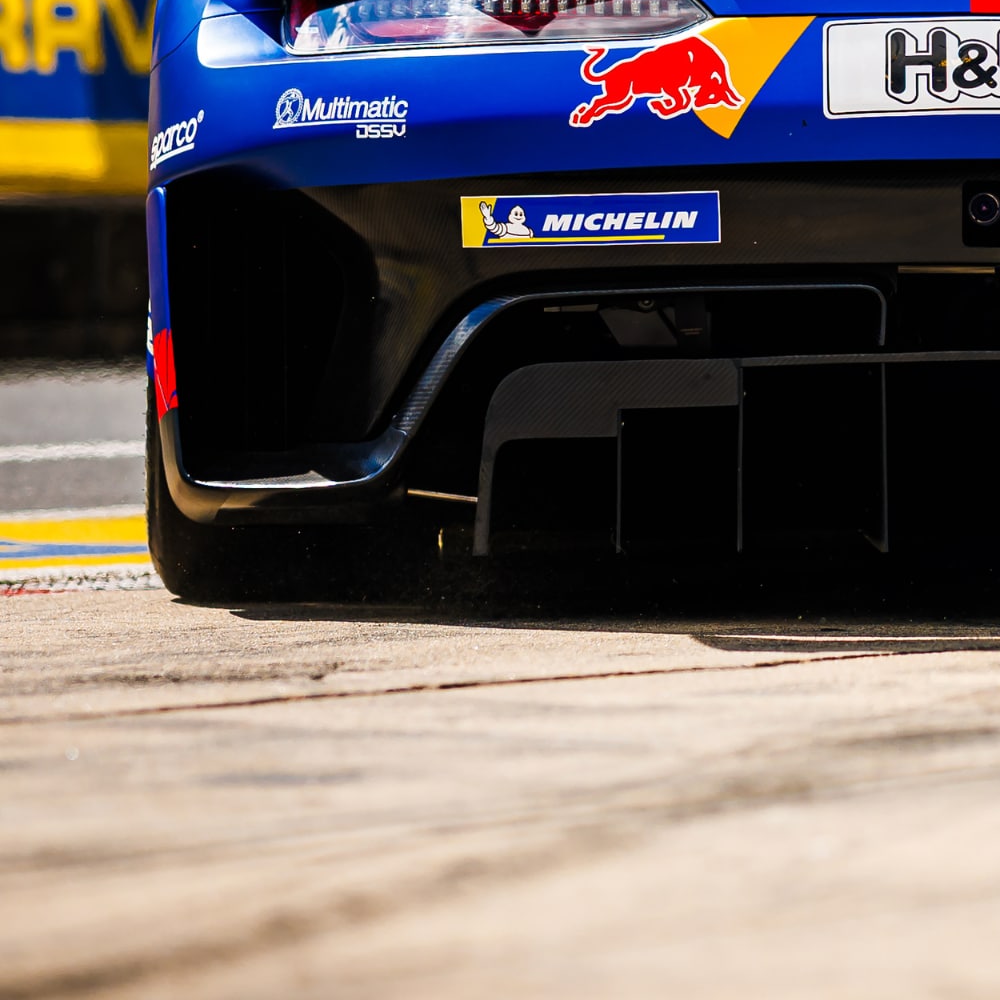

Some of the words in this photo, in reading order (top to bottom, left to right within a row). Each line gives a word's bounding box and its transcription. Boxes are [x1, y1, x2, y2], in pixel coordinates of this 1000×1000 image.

[301, 95, 409, 122] Multimatic
[151, 116, 199, 170] sparco
[356, 124, 406, 139] DSSV
[542, 210, 698, 232] MICHELIN
